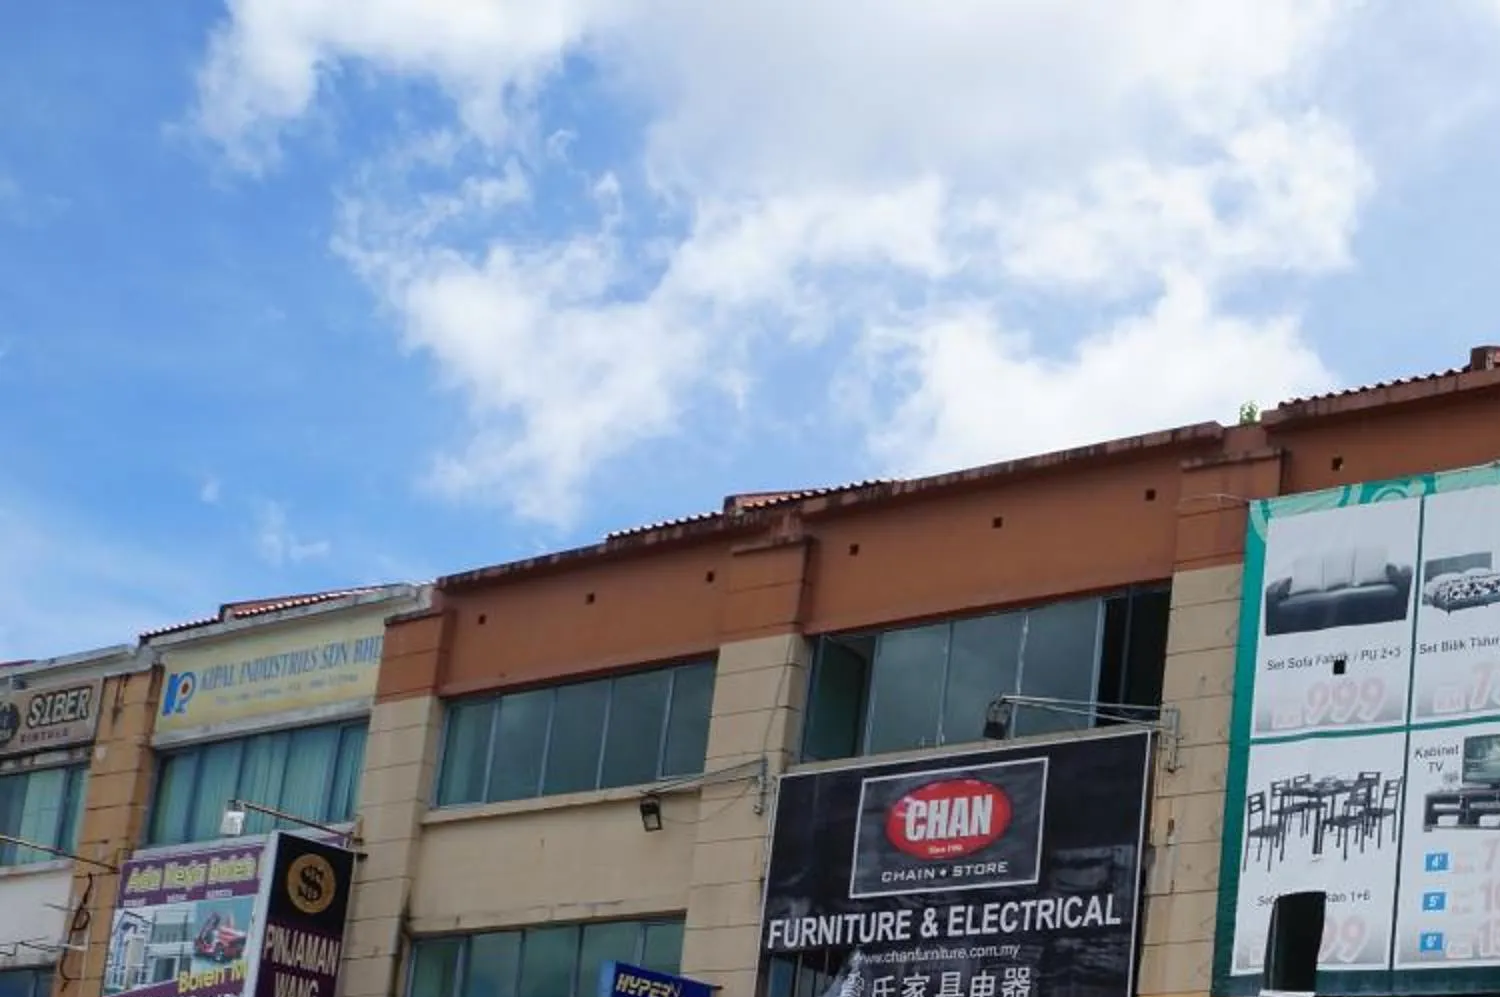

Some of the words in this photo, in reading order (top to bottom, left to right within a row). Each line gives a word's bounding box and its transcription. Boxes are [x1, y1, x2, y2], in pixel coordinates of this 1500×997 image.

[1287, 656, 1313, 669] Sofa
[27, 685, 92, 728] SIBER
[1428, 761, 1445, 773] TV
[903, 793, 993, 842] CHAN
[881, 867, 936, 884] CHAIN
[952, 861, 1009, 878] STORE
[767, 909, 912, 950] FURNITURE
[921, 908, 939, 939] &
[947, 894, 1122, 937] ELECTRICAL
[263, 924, 341, 977] PINJAMAN
